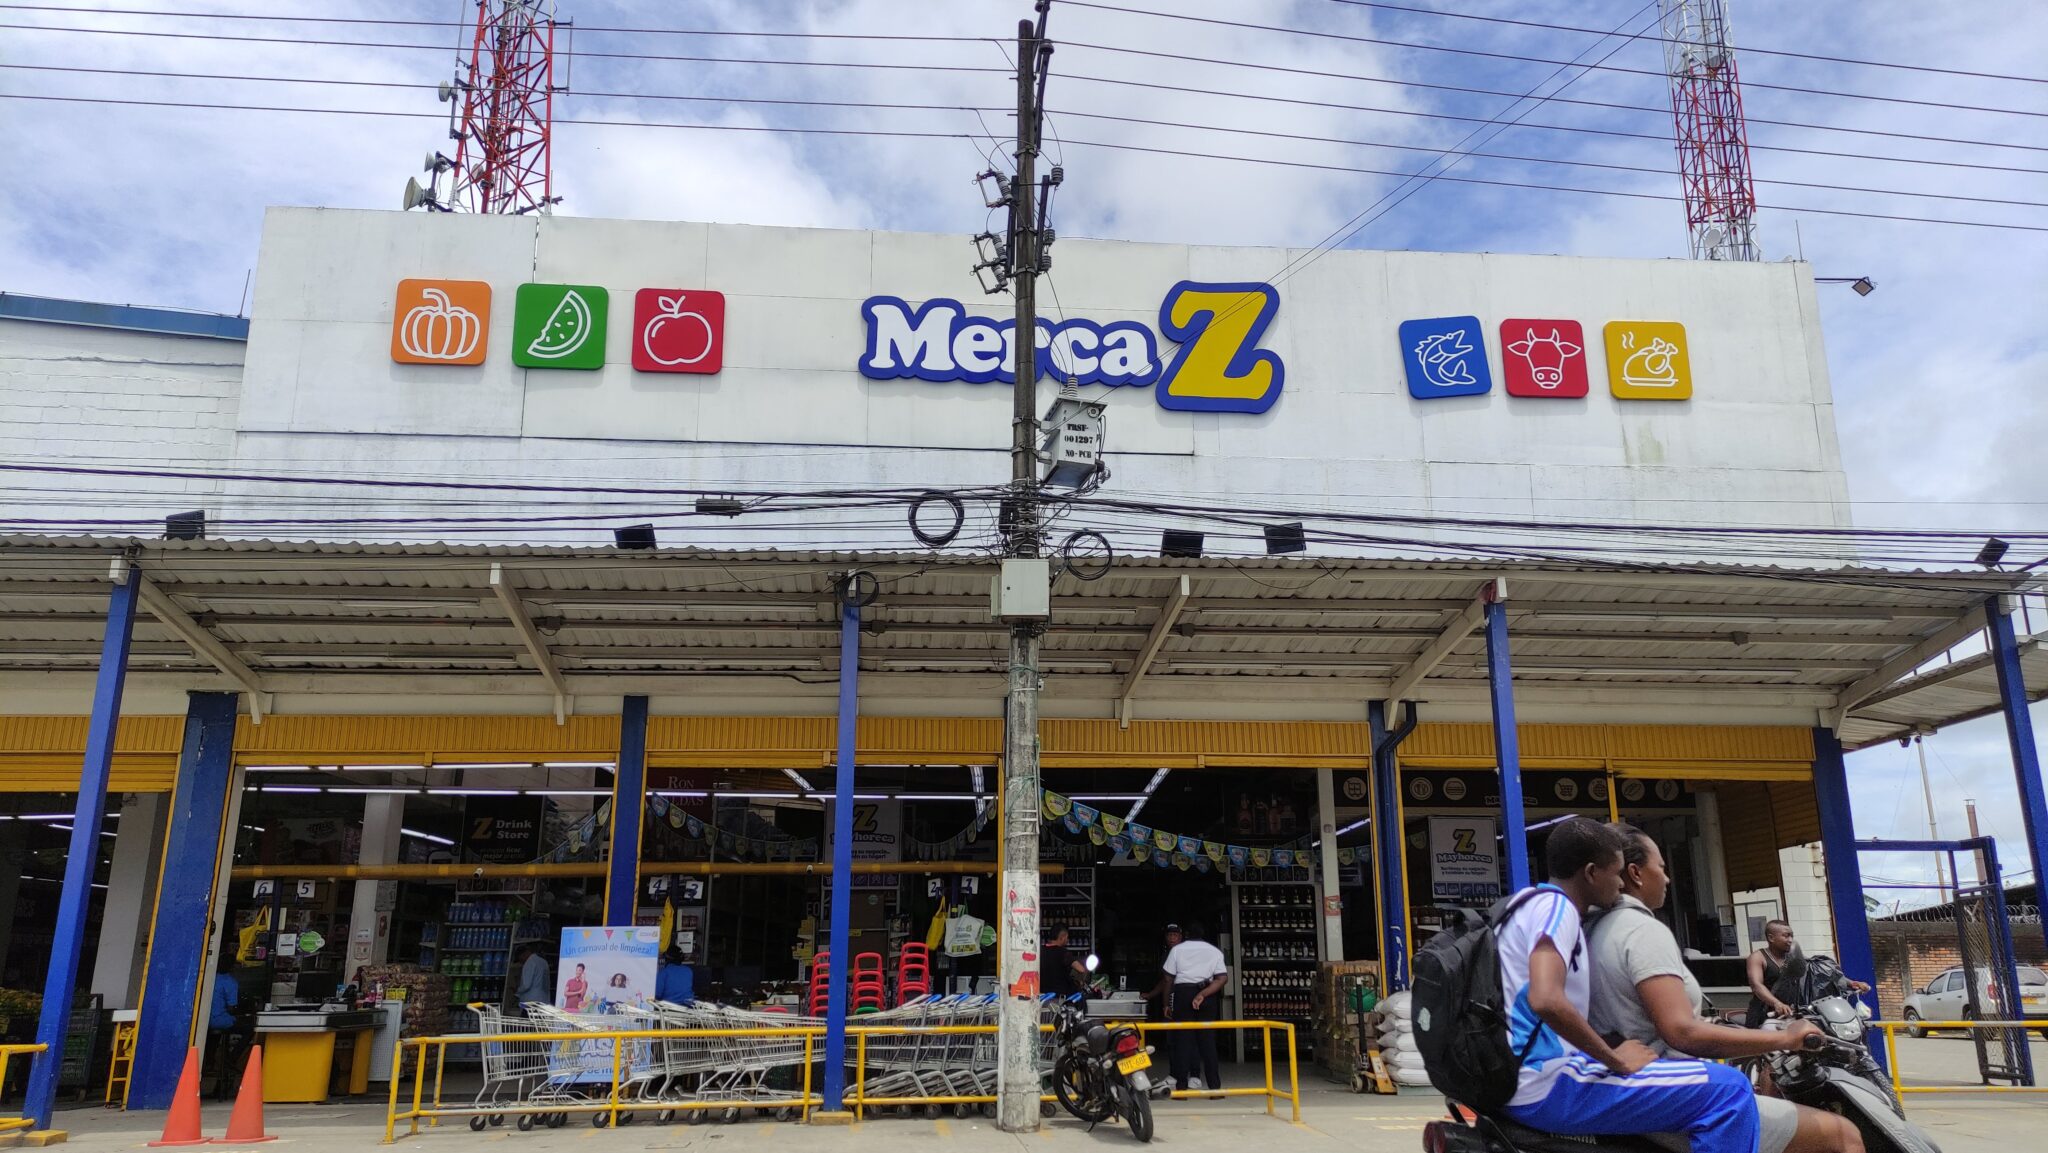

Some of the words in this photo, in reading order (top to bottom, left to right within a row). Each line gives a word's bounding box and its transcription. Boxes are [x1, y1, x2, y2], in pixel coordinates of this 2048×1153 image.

[1163, 286, 1278, 405] Z
[1064, 435, 1093, 444] 001297
[496, 819, 532, 829] Drink
[496, 830, 529, 839] Store
[1453, 829, 1477, 853] Z
[257, 882, 269, 894] 6
[301, 882, 311, 895] 5
[652, 879, 663, 892] 4
[931, 881, 938, 893] 2
[578, 943, 608, 953] carnaval
[609, 942, 619, 951] de
